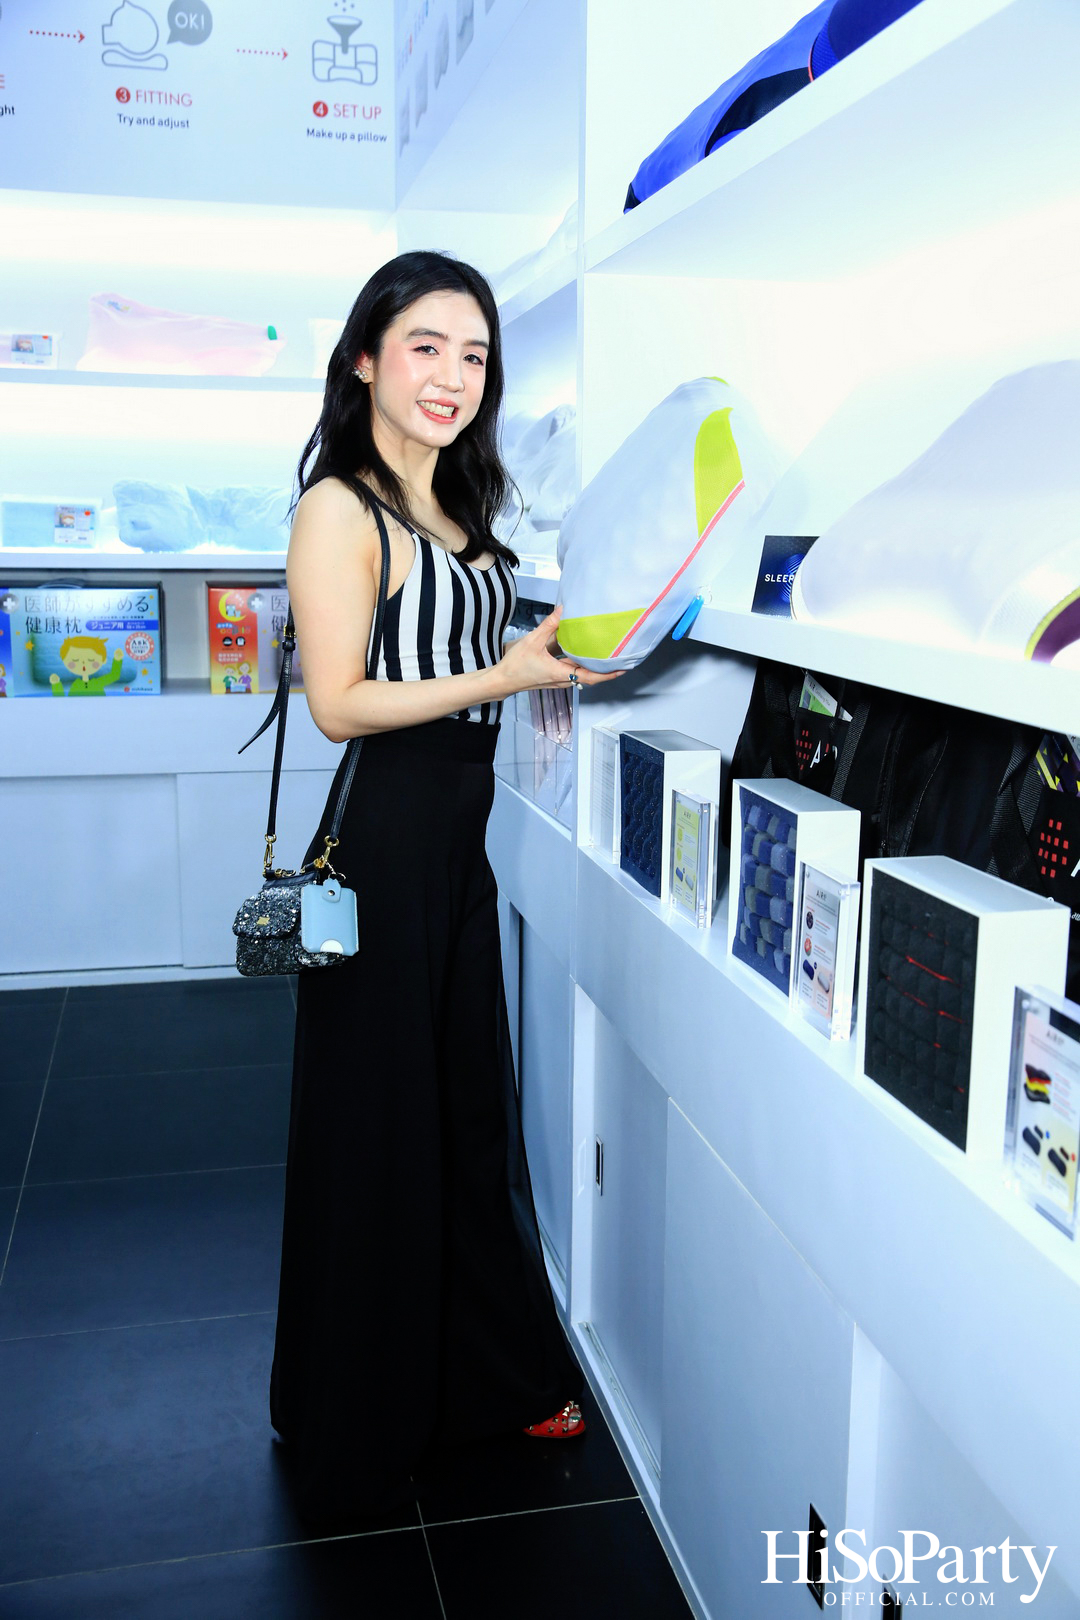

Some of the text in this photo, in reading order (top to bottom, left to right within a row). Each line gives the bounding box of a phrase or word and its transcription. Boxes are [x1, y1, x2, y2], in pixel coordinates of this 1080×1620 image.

[117, 87, 192, 107] 3 FITTING
[314, 101, 382, 120] 4 SET UP
[117, 113, 190, 130] Try and adjust
[306, 127, 333, 139] Make
[335, 131, 347, 142] up
[357, 131, 388, 143] pillow
[25, 616, 82, 634] 健康枕
